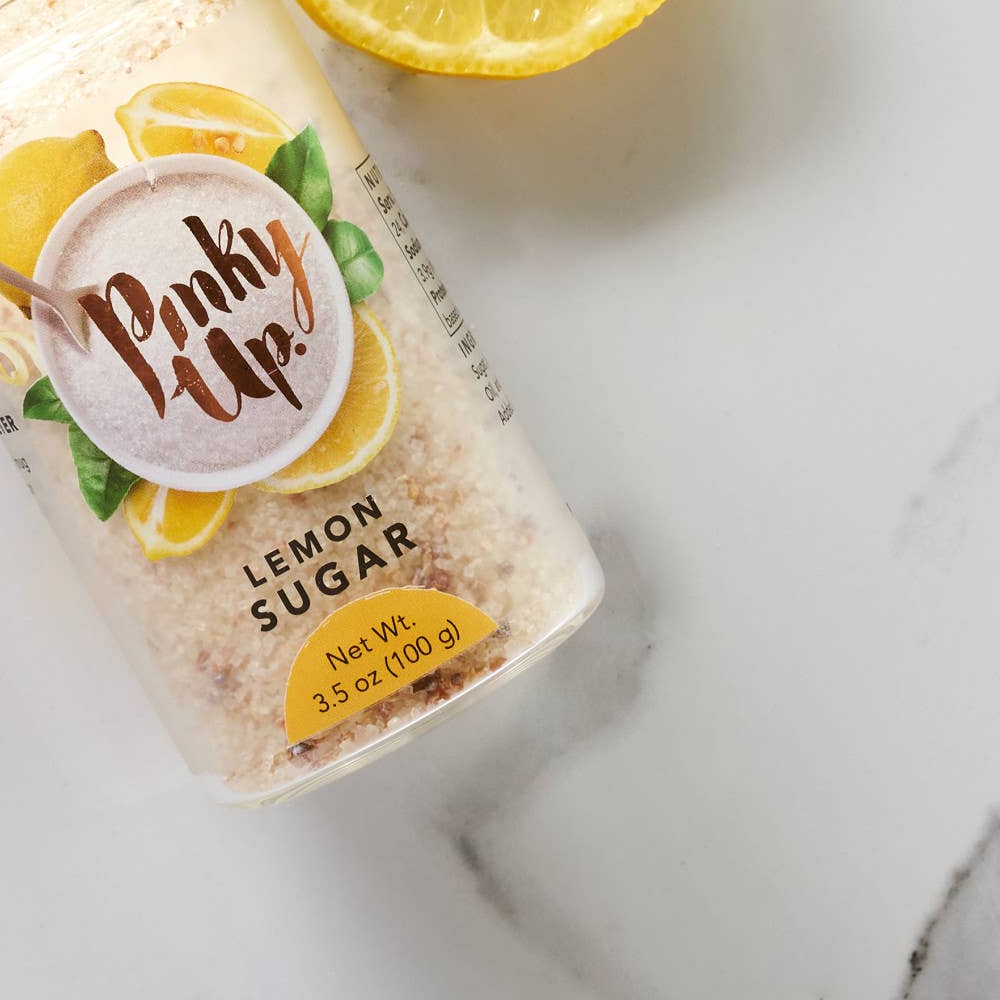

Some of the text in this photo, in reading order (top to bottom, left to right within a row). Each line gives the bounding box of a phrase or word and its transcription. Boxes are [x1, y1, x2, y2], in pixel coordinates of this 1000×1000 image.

[77, 215, 314, 420] Pinky
[242, 494, 383, 588] LEMON
[250, 522, 417, 632] SUGAR
[312, 618, 461, 713] 3.5 oz (100 g)
[325, 614, 416, 671] Net Wt.
